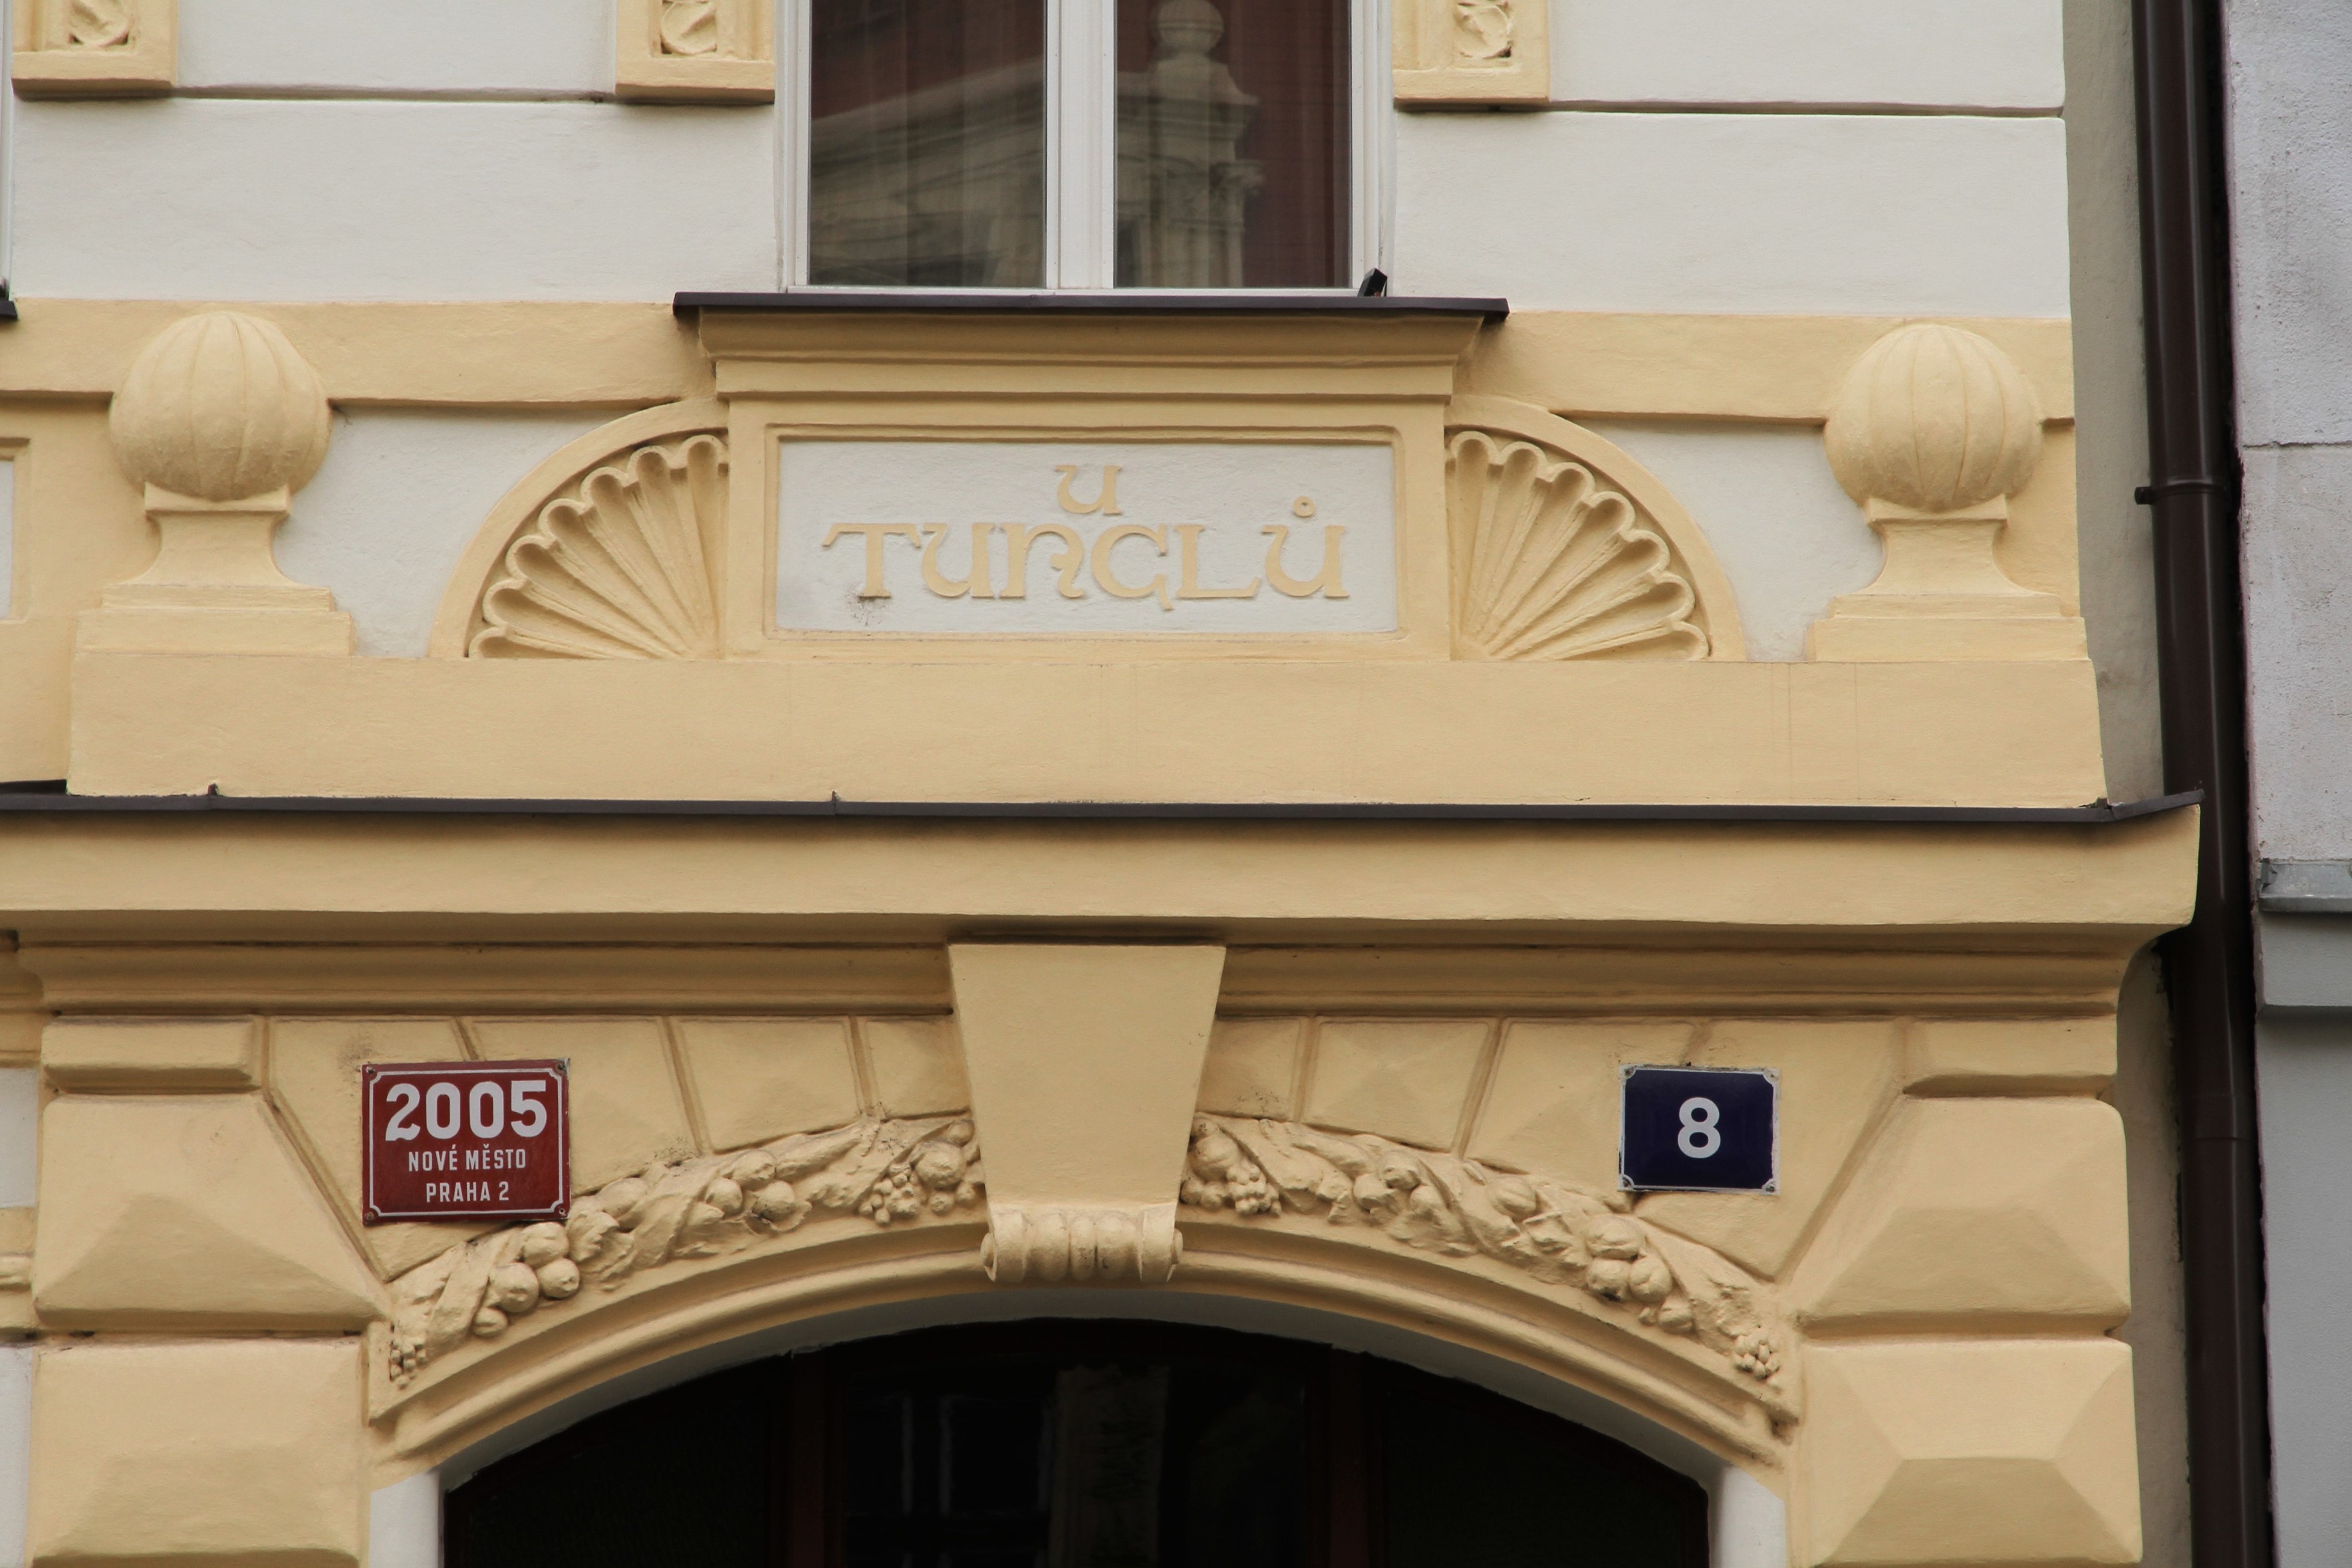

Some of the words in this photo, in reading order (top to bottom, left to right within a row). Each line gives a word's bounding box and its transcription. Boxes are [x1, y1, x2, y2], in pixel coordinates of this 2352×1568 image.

[385, 1080, 547, 1142] 2005
[1677, 1097, 1722, 1159] 8
[408, 1144, 458, 1172] NOVÉ
[465, 1144, 527, 1170] MĚSTO
[426, 1182, 491, 1203] PRAHA
[499, 1182, 509, 1201] 2
